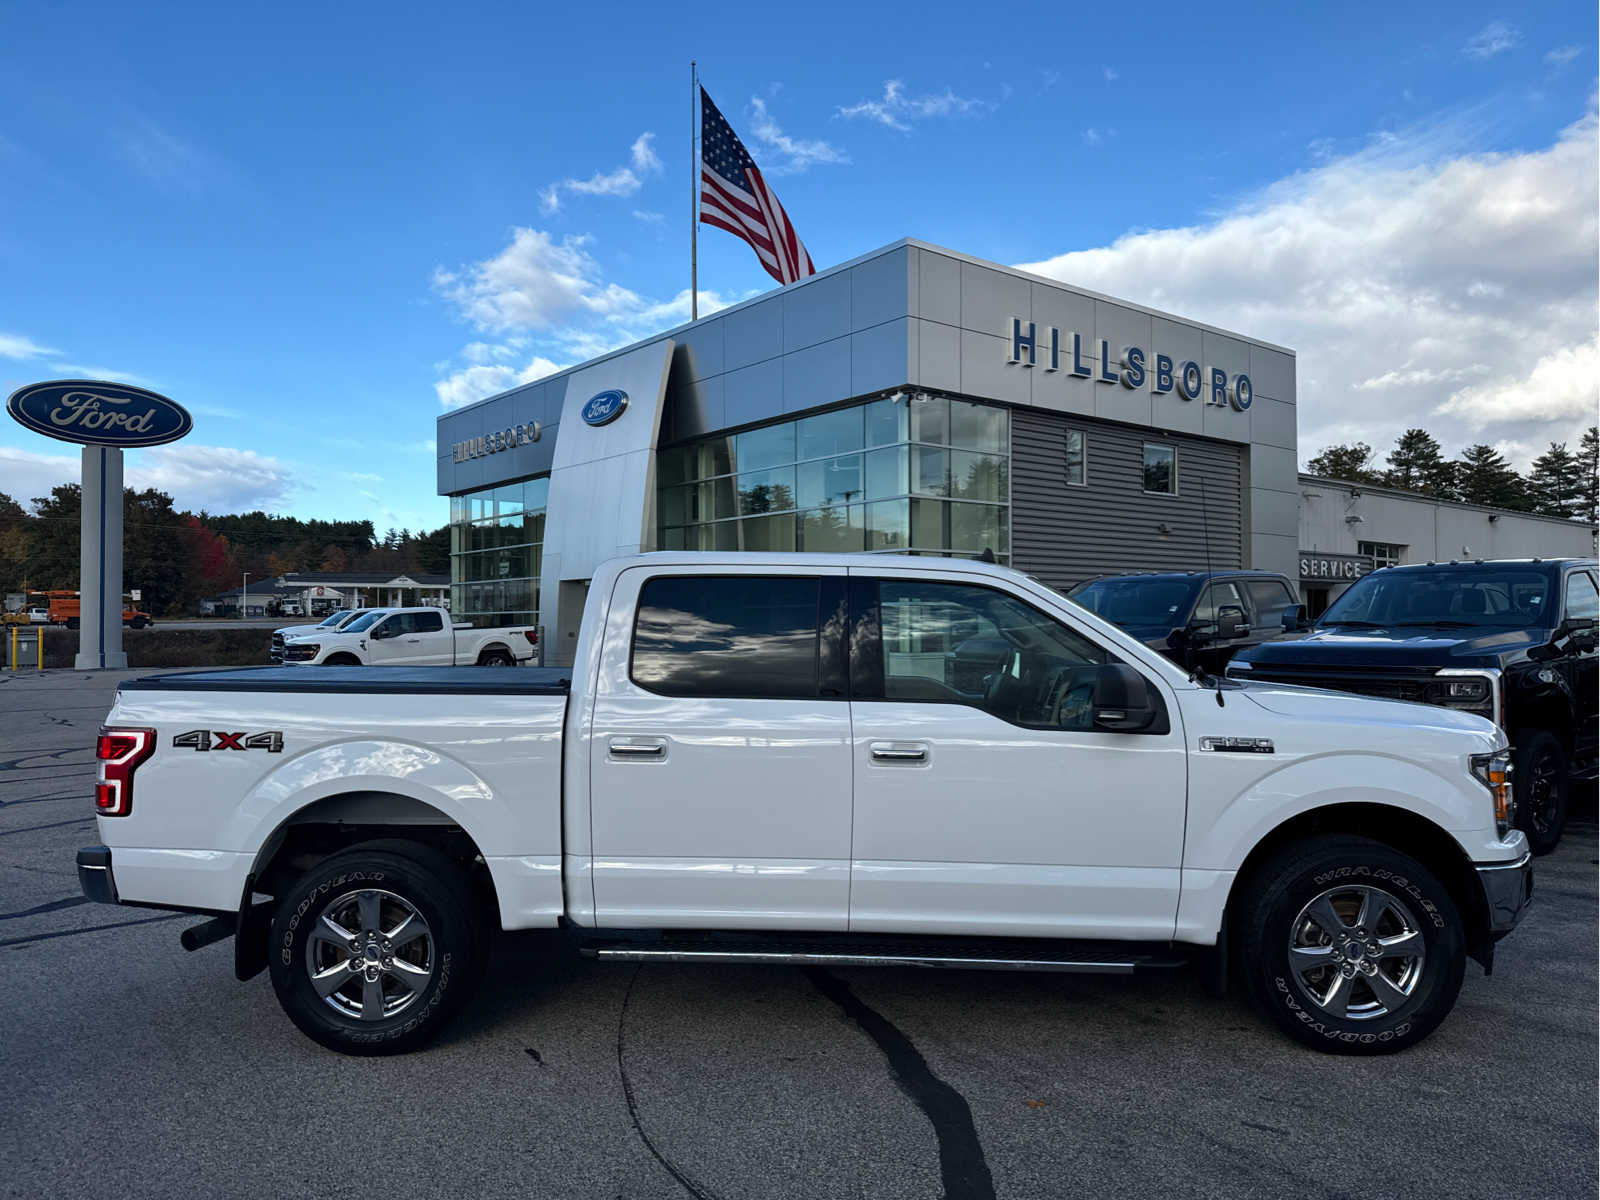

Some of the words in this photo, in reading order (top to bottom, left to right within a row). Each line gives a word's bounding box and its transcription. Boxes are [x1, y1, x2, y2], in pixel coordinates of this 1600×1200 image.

[1008, 317, 1252, 411] HILLSBORO
[51, 391, 154, 433] Ford
[588, 398, 613, 418] Ford
[452, 421, 541, 464] HILLSBORO
[1300, 559, 1361, 578] SERVICE
[281, 871, 385, 966] GOODYEAR
[1313, 865, 1445, 929] WRANGLER
[1275, 976, 1412, 1043] GOODYEAR
